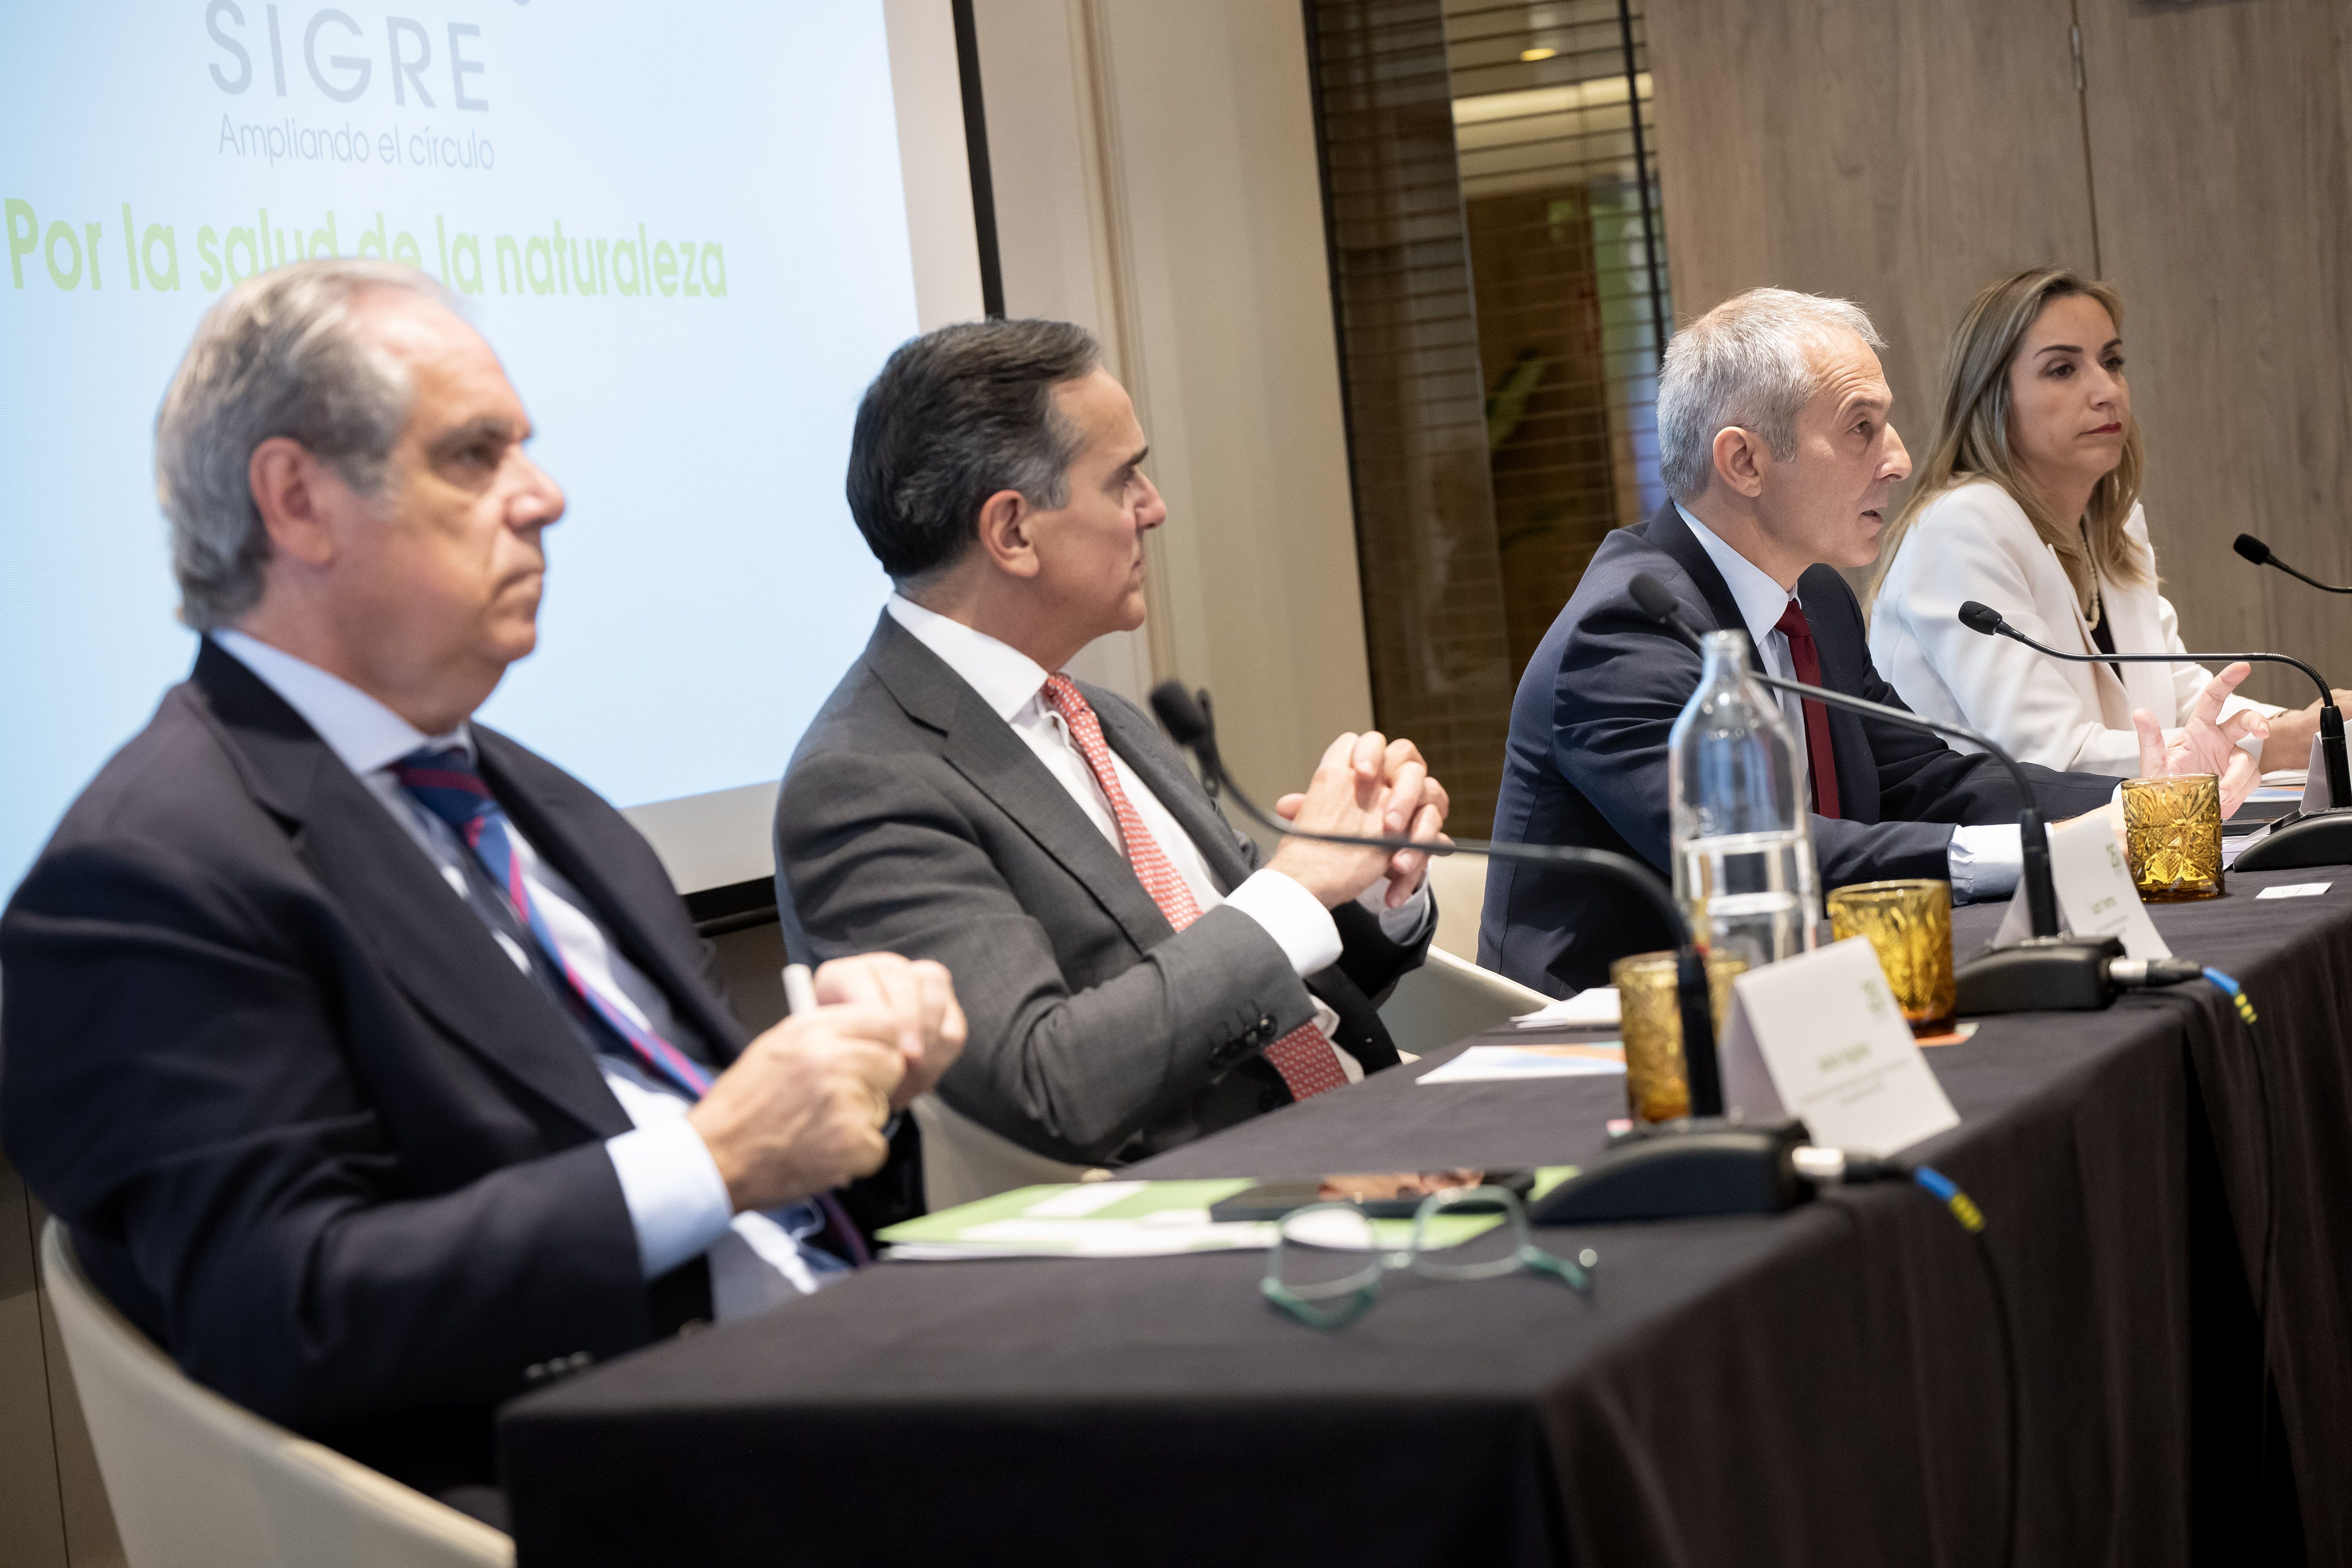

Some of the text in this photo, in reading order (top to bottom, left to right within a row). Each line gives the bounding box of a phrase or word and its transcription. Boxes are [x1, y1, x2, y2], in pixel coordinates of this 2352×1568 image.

[205, 0, 489, 112] SIGRE
[219, 112, 494, 170] Ampliando el círculo
[4, 198, 103, 291] Por
[121, 202, 181, 292] la
[435, 214, 484, 295] la
[494, 219, 728, 298] naturaleza
